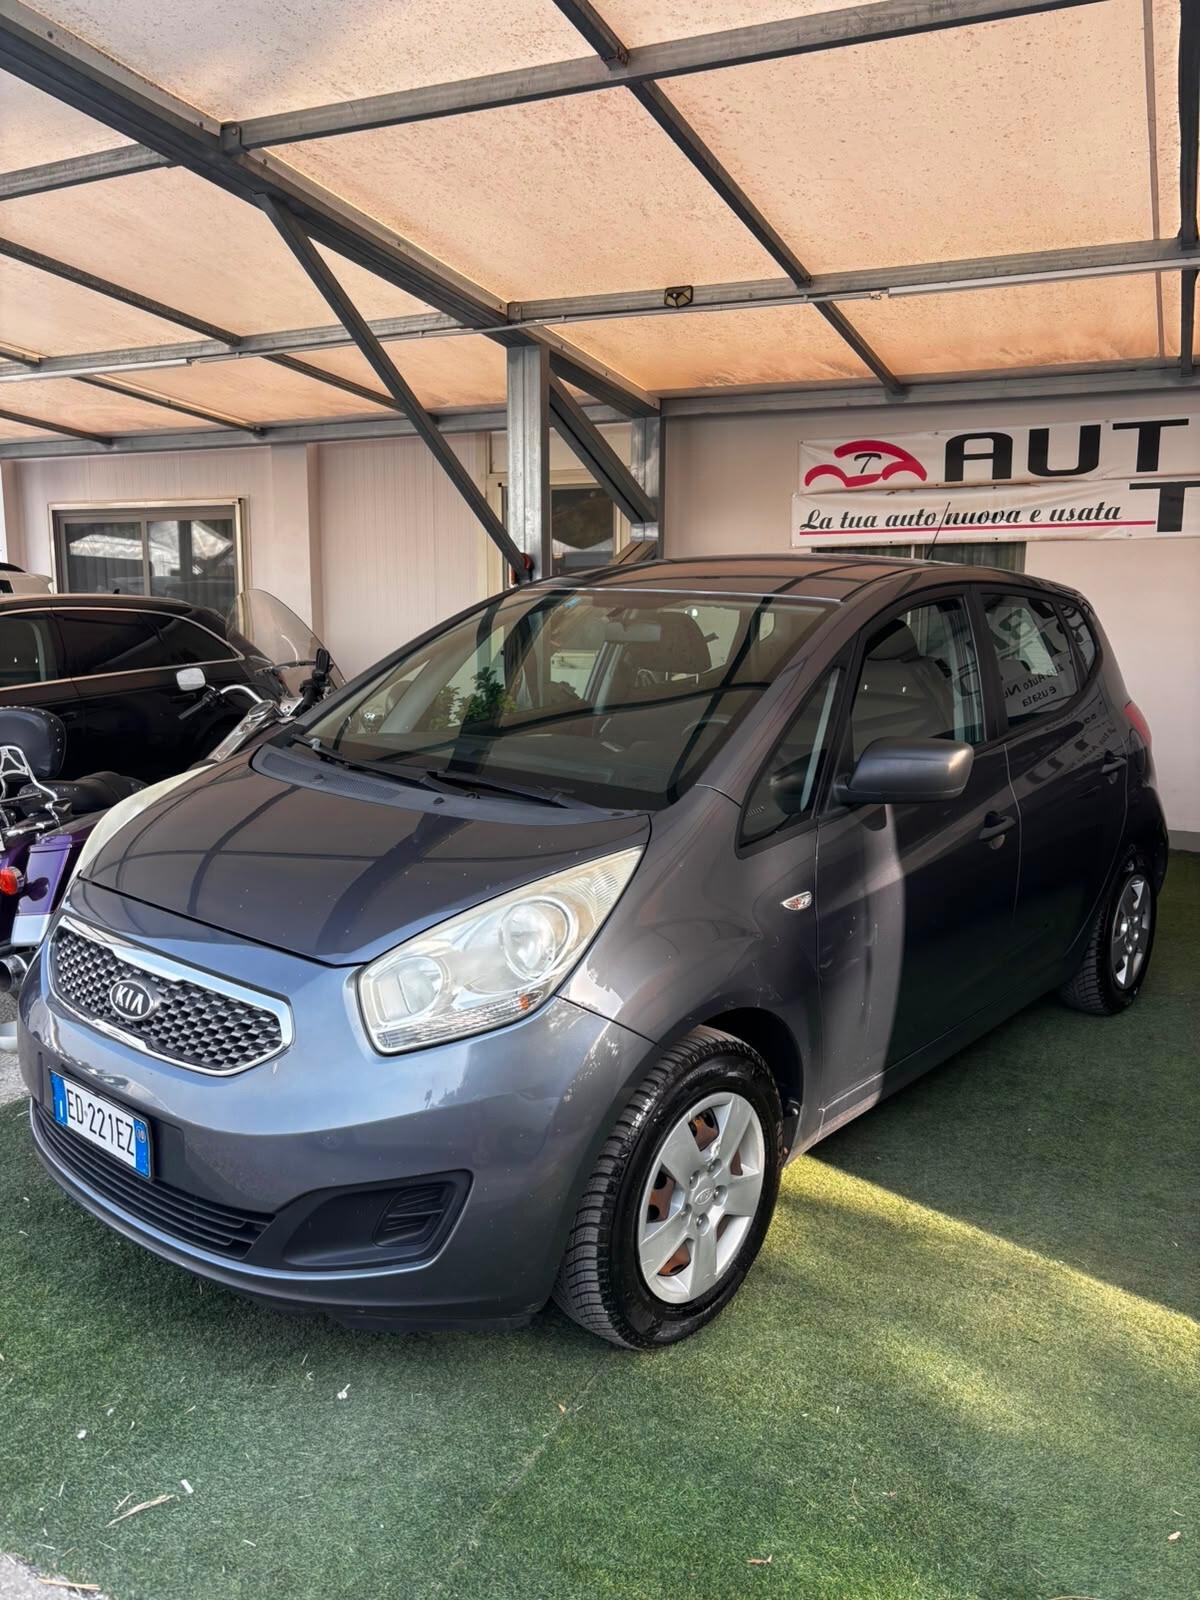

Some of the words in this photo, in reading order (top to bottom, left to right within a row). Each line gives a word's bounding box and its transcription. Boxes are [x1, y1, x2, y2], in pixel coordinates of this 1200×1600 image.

[944, 418, 1189, 483] AUT
[800, 509, 833, 530] La
[840, 511, 878, 529] tua
[885, 508, 937, 528] auto
[944, 508, 1022, 526] nuova
[1029, 508, 1042, 523] e
[1049, 501, 1123, 523] usata
[115, 984, 144, 1015] KIA
